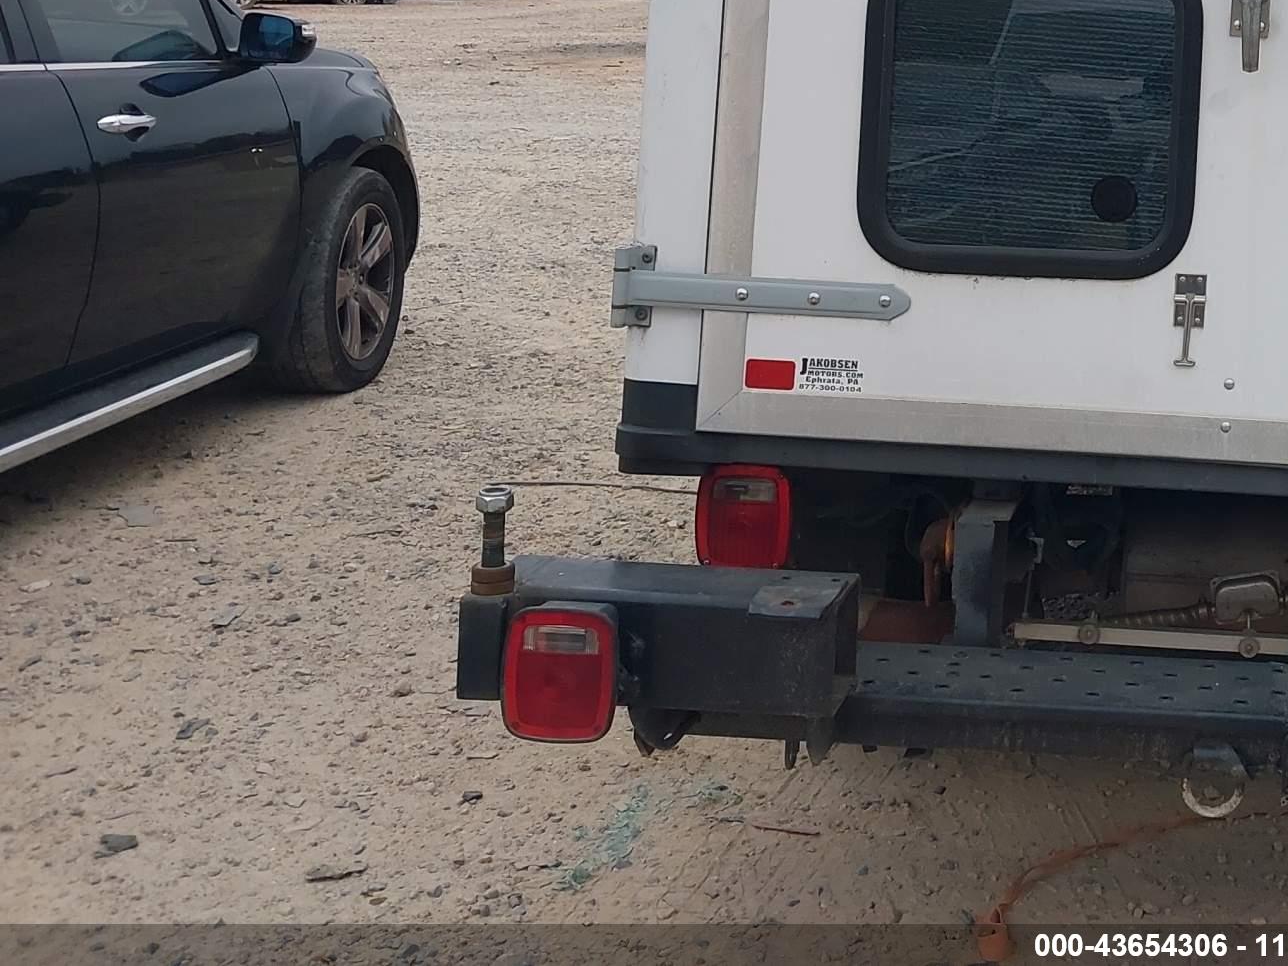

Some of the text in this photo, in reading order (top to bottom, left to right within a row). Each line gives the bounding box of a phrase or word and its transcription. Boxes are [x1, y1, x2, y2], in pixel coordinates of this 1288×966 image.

[800, 358, 858, 375] JAKOBSEN
[807, 370, 864, 379] MOTORS.COM
[805, 376, 844, 386] Ephrata,
[799, 383, 862, 393] 877-300-0104
